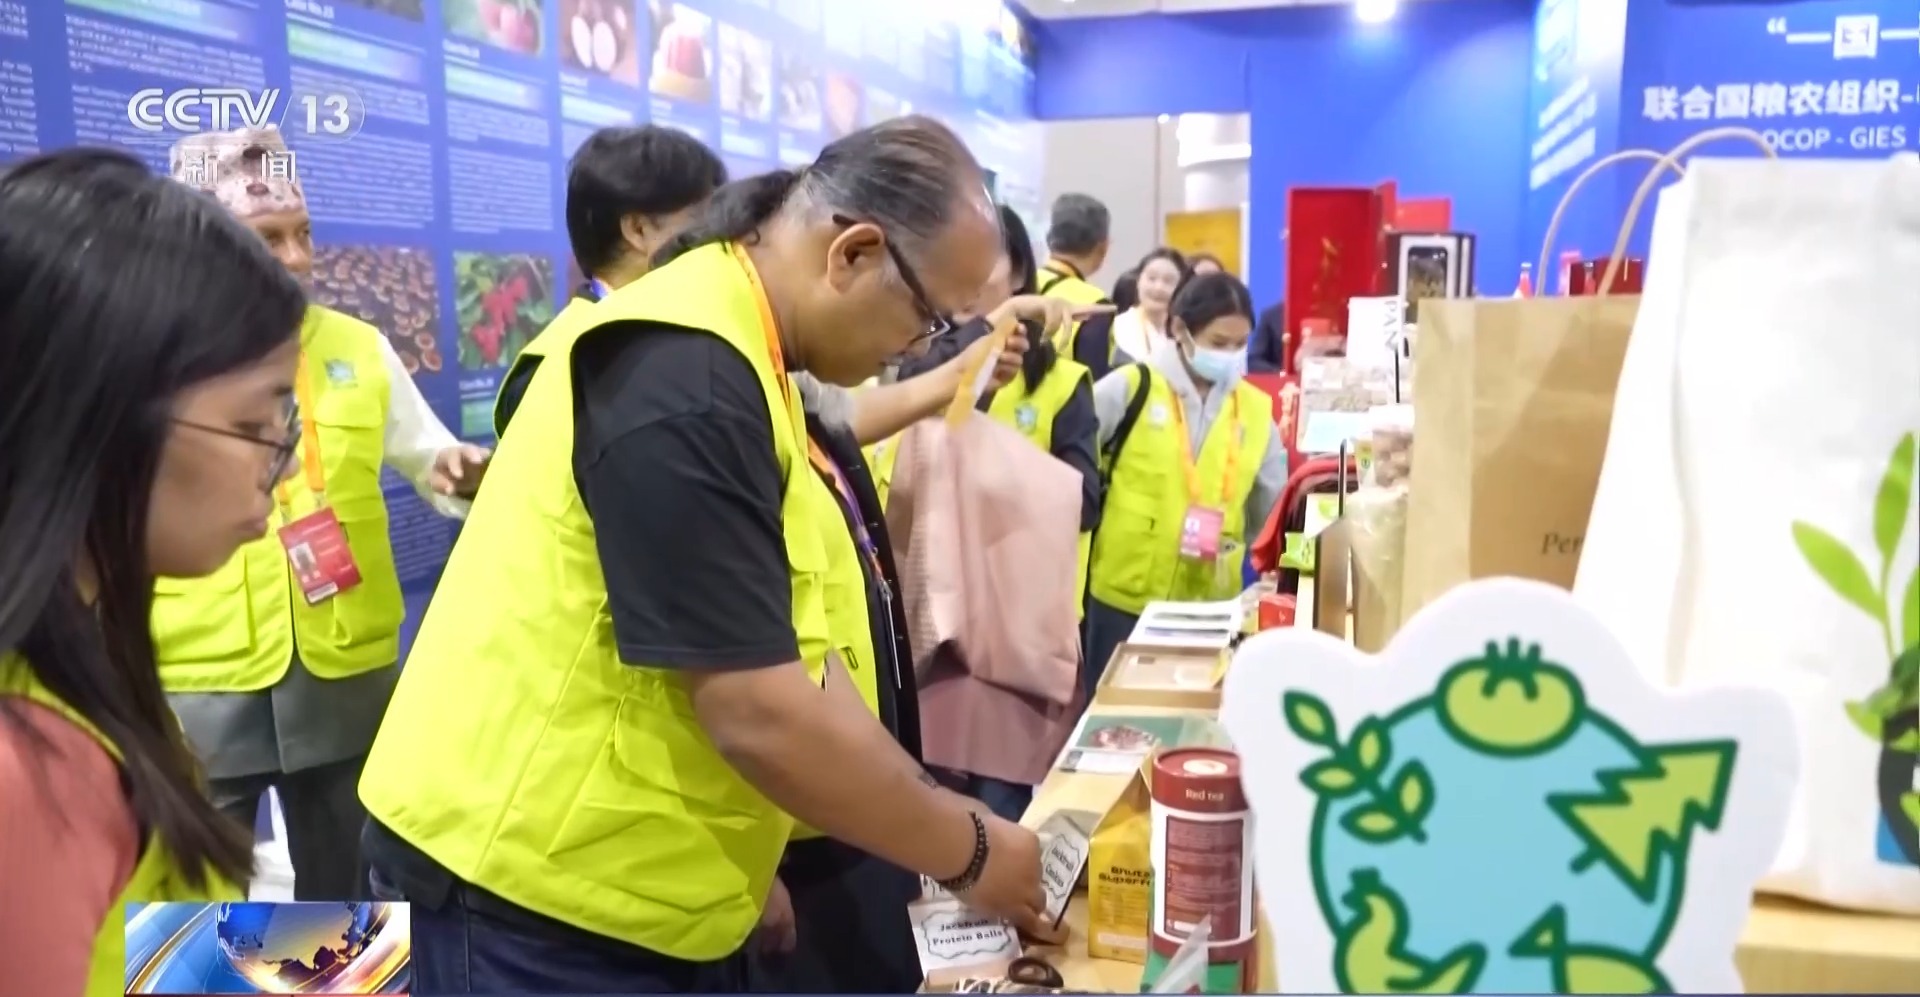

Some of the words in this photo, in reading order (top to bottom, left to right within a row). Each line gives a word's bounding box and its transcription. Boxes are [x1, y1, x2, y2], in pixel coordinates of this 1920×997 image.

[1766, 14, 1920, 60] “一国一
[1642, 79, 1920, 121] 联合国粮农组织-
[1761, 128, 1831, 151] OCOP
[1849, 126, 1907, 149] GIES
[1185, 787, 1206, 801] Red
[932, 934, 973, 946] Protein
[976, 929, 1003, 940] Balls
